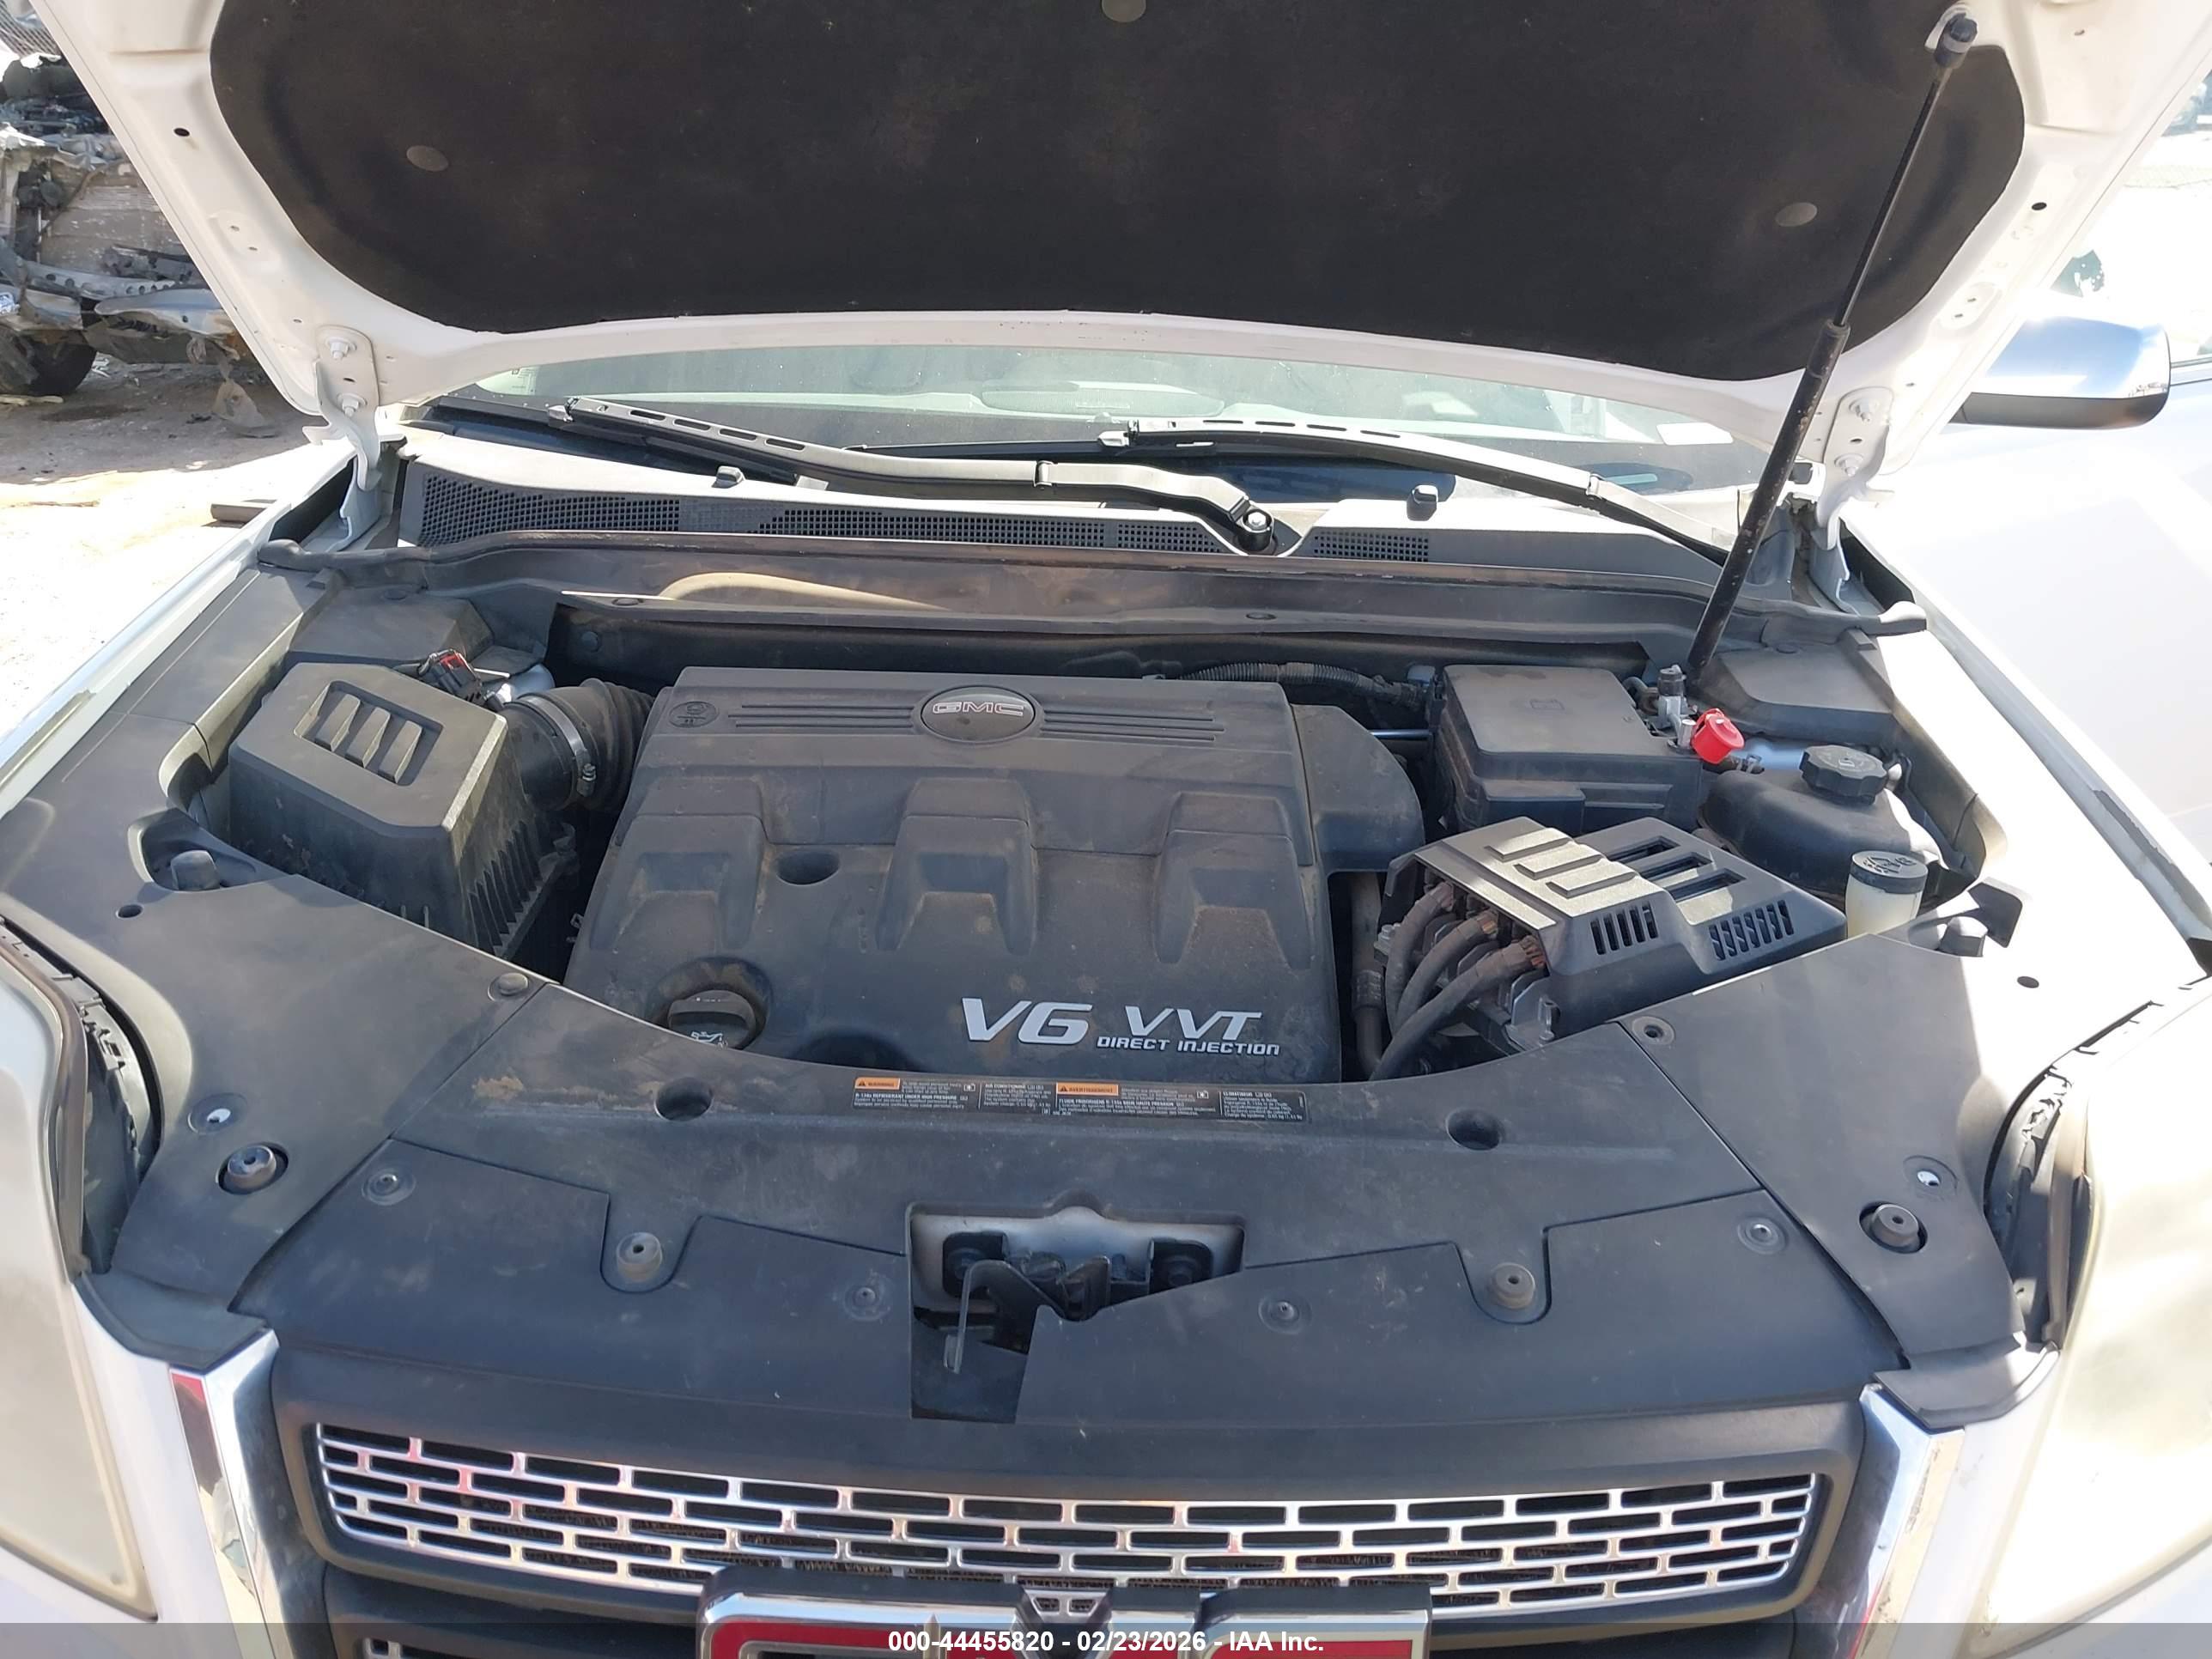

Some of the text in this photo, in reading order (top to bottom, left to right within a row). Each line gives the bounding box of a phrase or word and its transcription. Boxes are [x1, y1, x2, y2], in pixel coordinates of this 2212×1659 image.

[933, 702, 1024, 717] GMC
[962, 998, 1262, 1045] V6 VVT
[1097, 1036, 1279, 1056] DIRECT INJECTION
